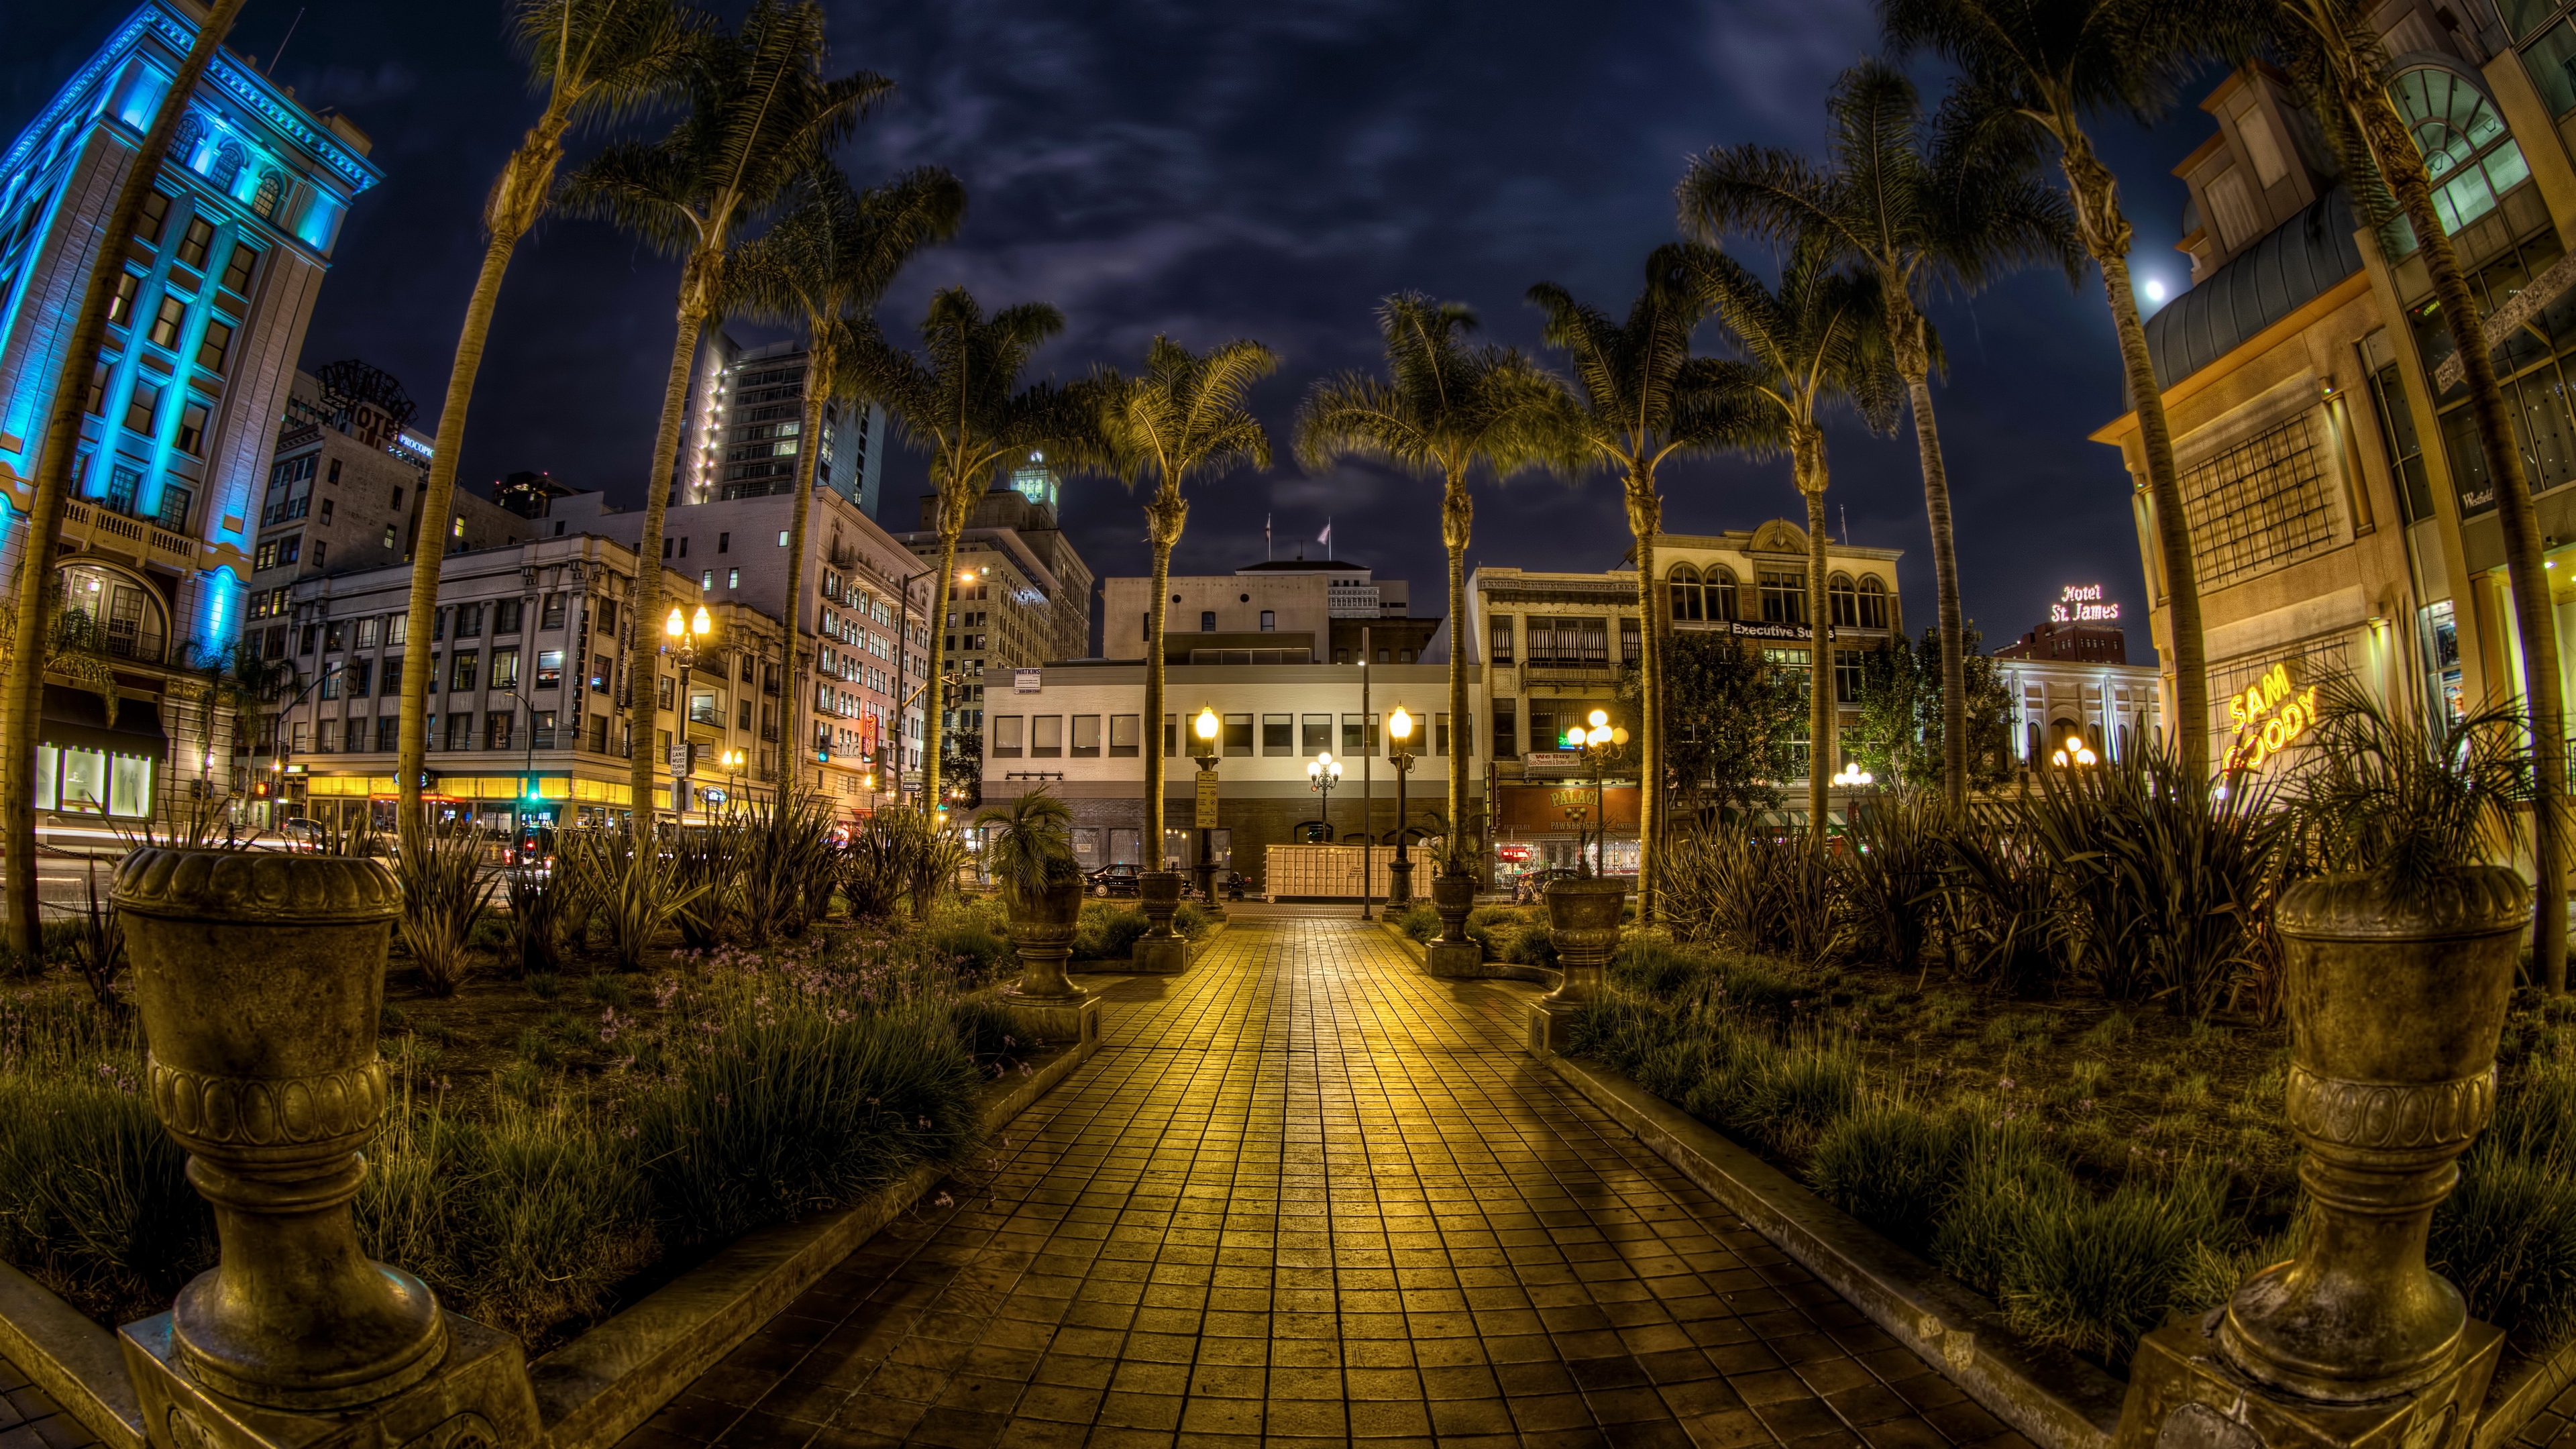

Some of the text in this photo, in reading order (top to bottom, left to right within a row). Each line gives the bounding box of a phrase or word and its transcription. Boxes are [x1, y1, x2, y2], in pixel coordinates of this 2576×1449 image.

[2462, 488, 2493, 510] Westfield
[2061, 584, 2102, 602] Hotel
[2072, 602, 2118, 621] James
[1732, 623, 1835, 638] Executive Sus
[2229, 663, 2292, 735] SAM
